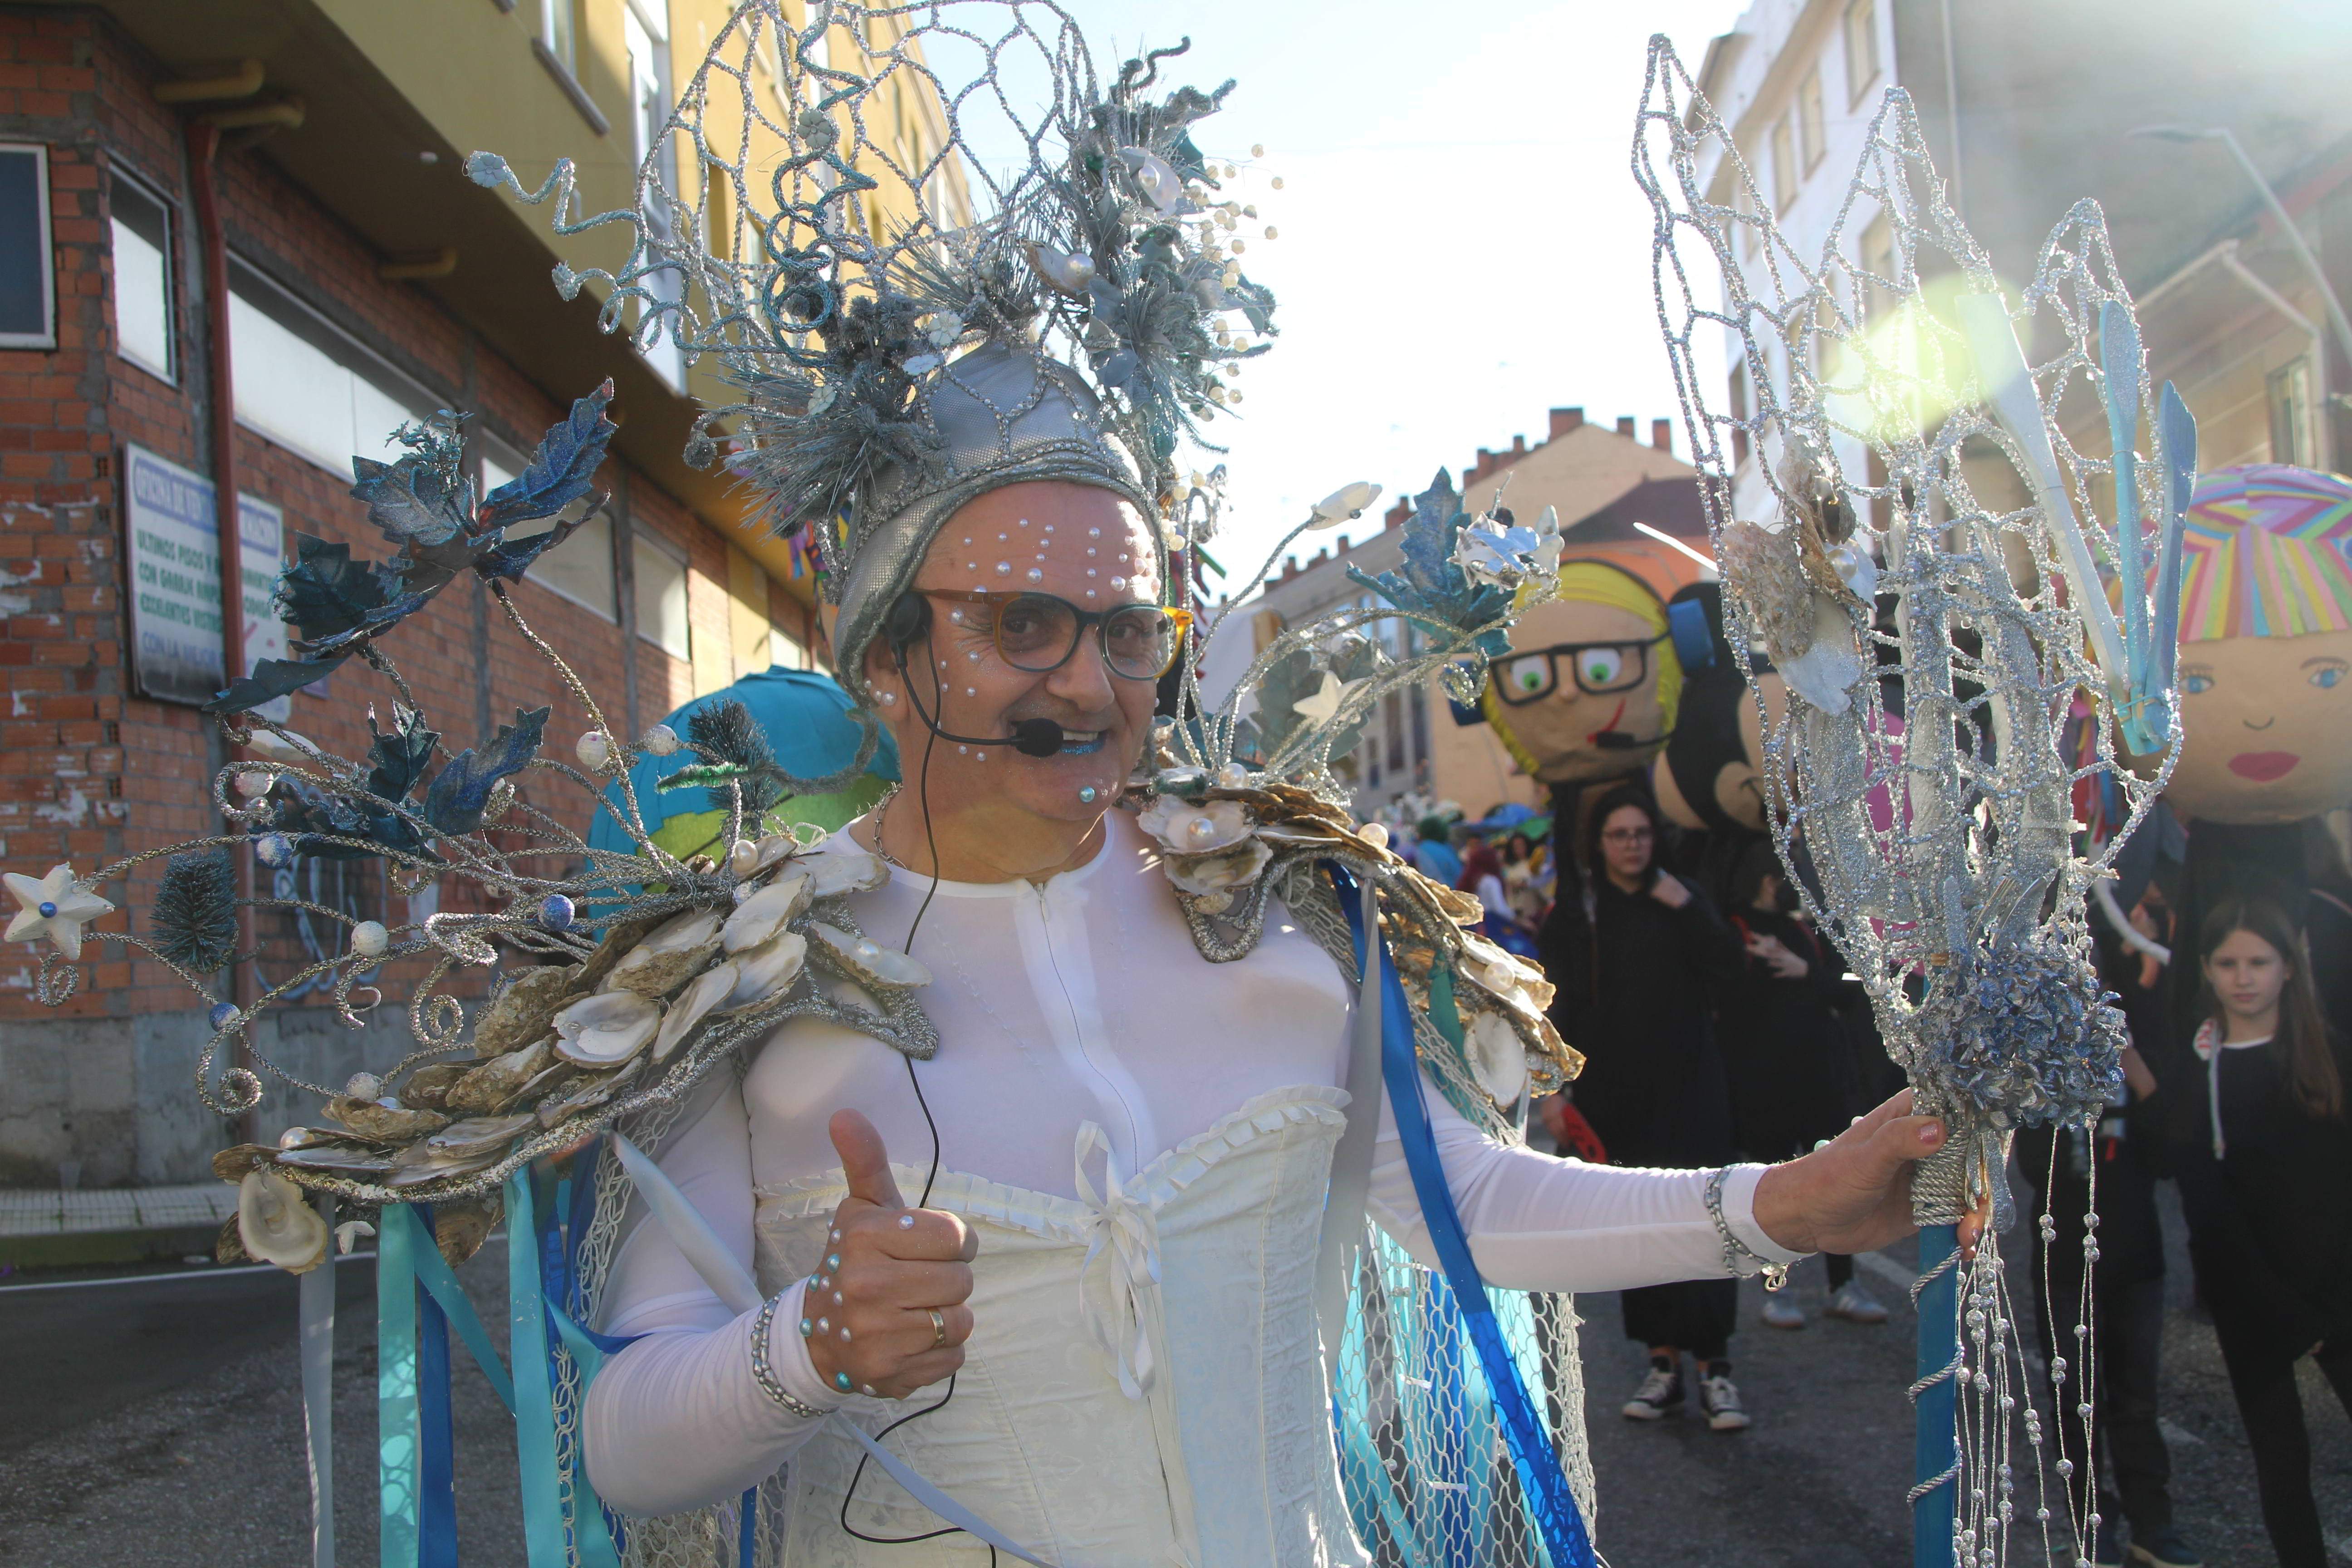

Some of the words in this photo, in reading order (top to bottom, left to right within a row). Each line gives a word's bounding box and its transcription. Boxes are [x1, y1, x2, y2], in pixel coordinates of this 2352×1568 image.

[172, 482, 186, 516] DE
[137, 529, 175, 560] ULTIMOS
[177, 544, 204, 569] PISOS
[138, 560, 157, 585] CON
[142, 631, 165, 655] CON
